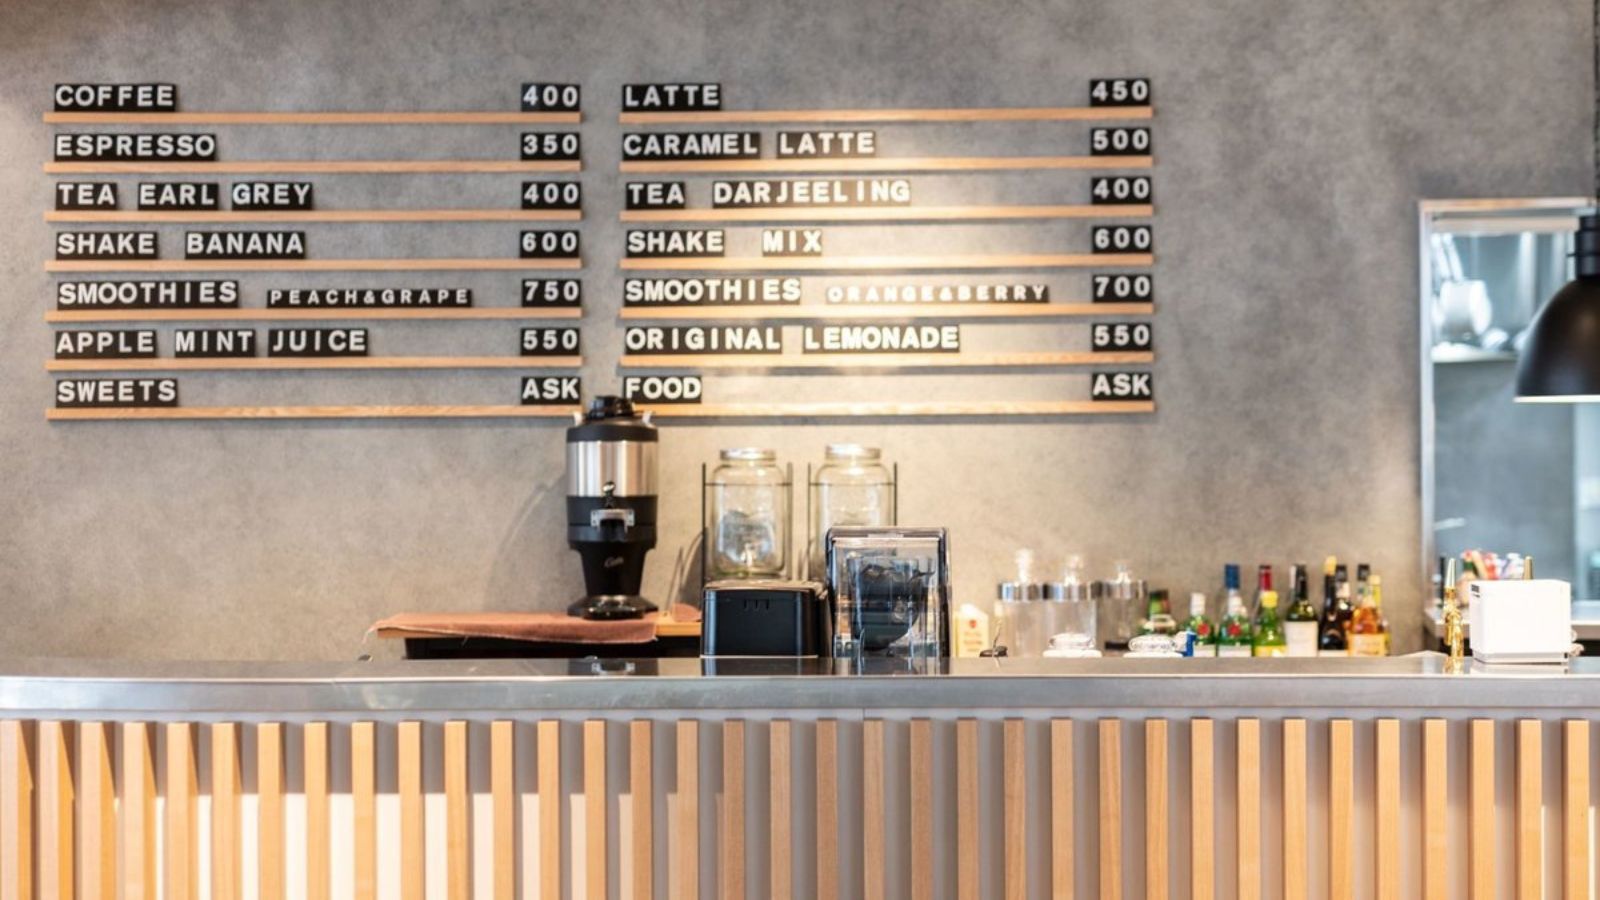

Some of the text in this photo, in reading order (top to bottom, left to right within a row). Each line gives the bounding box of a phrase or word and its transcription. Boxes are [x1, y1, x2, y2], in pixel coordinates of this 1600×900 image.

[56, 85, 172, 106] COFFEE
[524, 85, 577, 106] 400
[626, 85, 719, 106] LATTE
[1093, 81, 1147, 100] 450
[57, 135, 214, 156] ESPRESSO
[524, 134, 577, 154] 350
[624, 133, 874, 155] CARAMEL LATTE
[1094, 129, 1148, 150] 500
[59, 184, 309, 204] TEA EARL GREY
[524, 183, 578, 203] 400
[629, 182, 909, 203] TEA DARJEELING
[1094, 178, 1149, 198] 400
[58, 233, 303, 254] SHAKE BANANA
[523, 232, 576, 251] 600
[629, 231, 821, 252] SHAKE MIX
[1096, 228, 1150, 248] 600
[59, 282, 467, 304] SMOOTHIES PEACH&GRAPE
[525, 281, 578, 300] 750
[627, 280, 800, 301] SMOOTHIES
[1095, 276, 1150, 297] 700
[57, 330, 365, 353] APPLE MINT JUICE
[524, 330, 577, 349] 550
[626, 327, 958, 350] ORIGINAL LEMONADE
[1095, 325, 1149, 346] 550
[58, 381, 175, 402] SWEETS
[523, 379, 578, 399] ASK
[626, 378, 700, 399] FOOD
[1094, 375, 1149, 395] ASK
